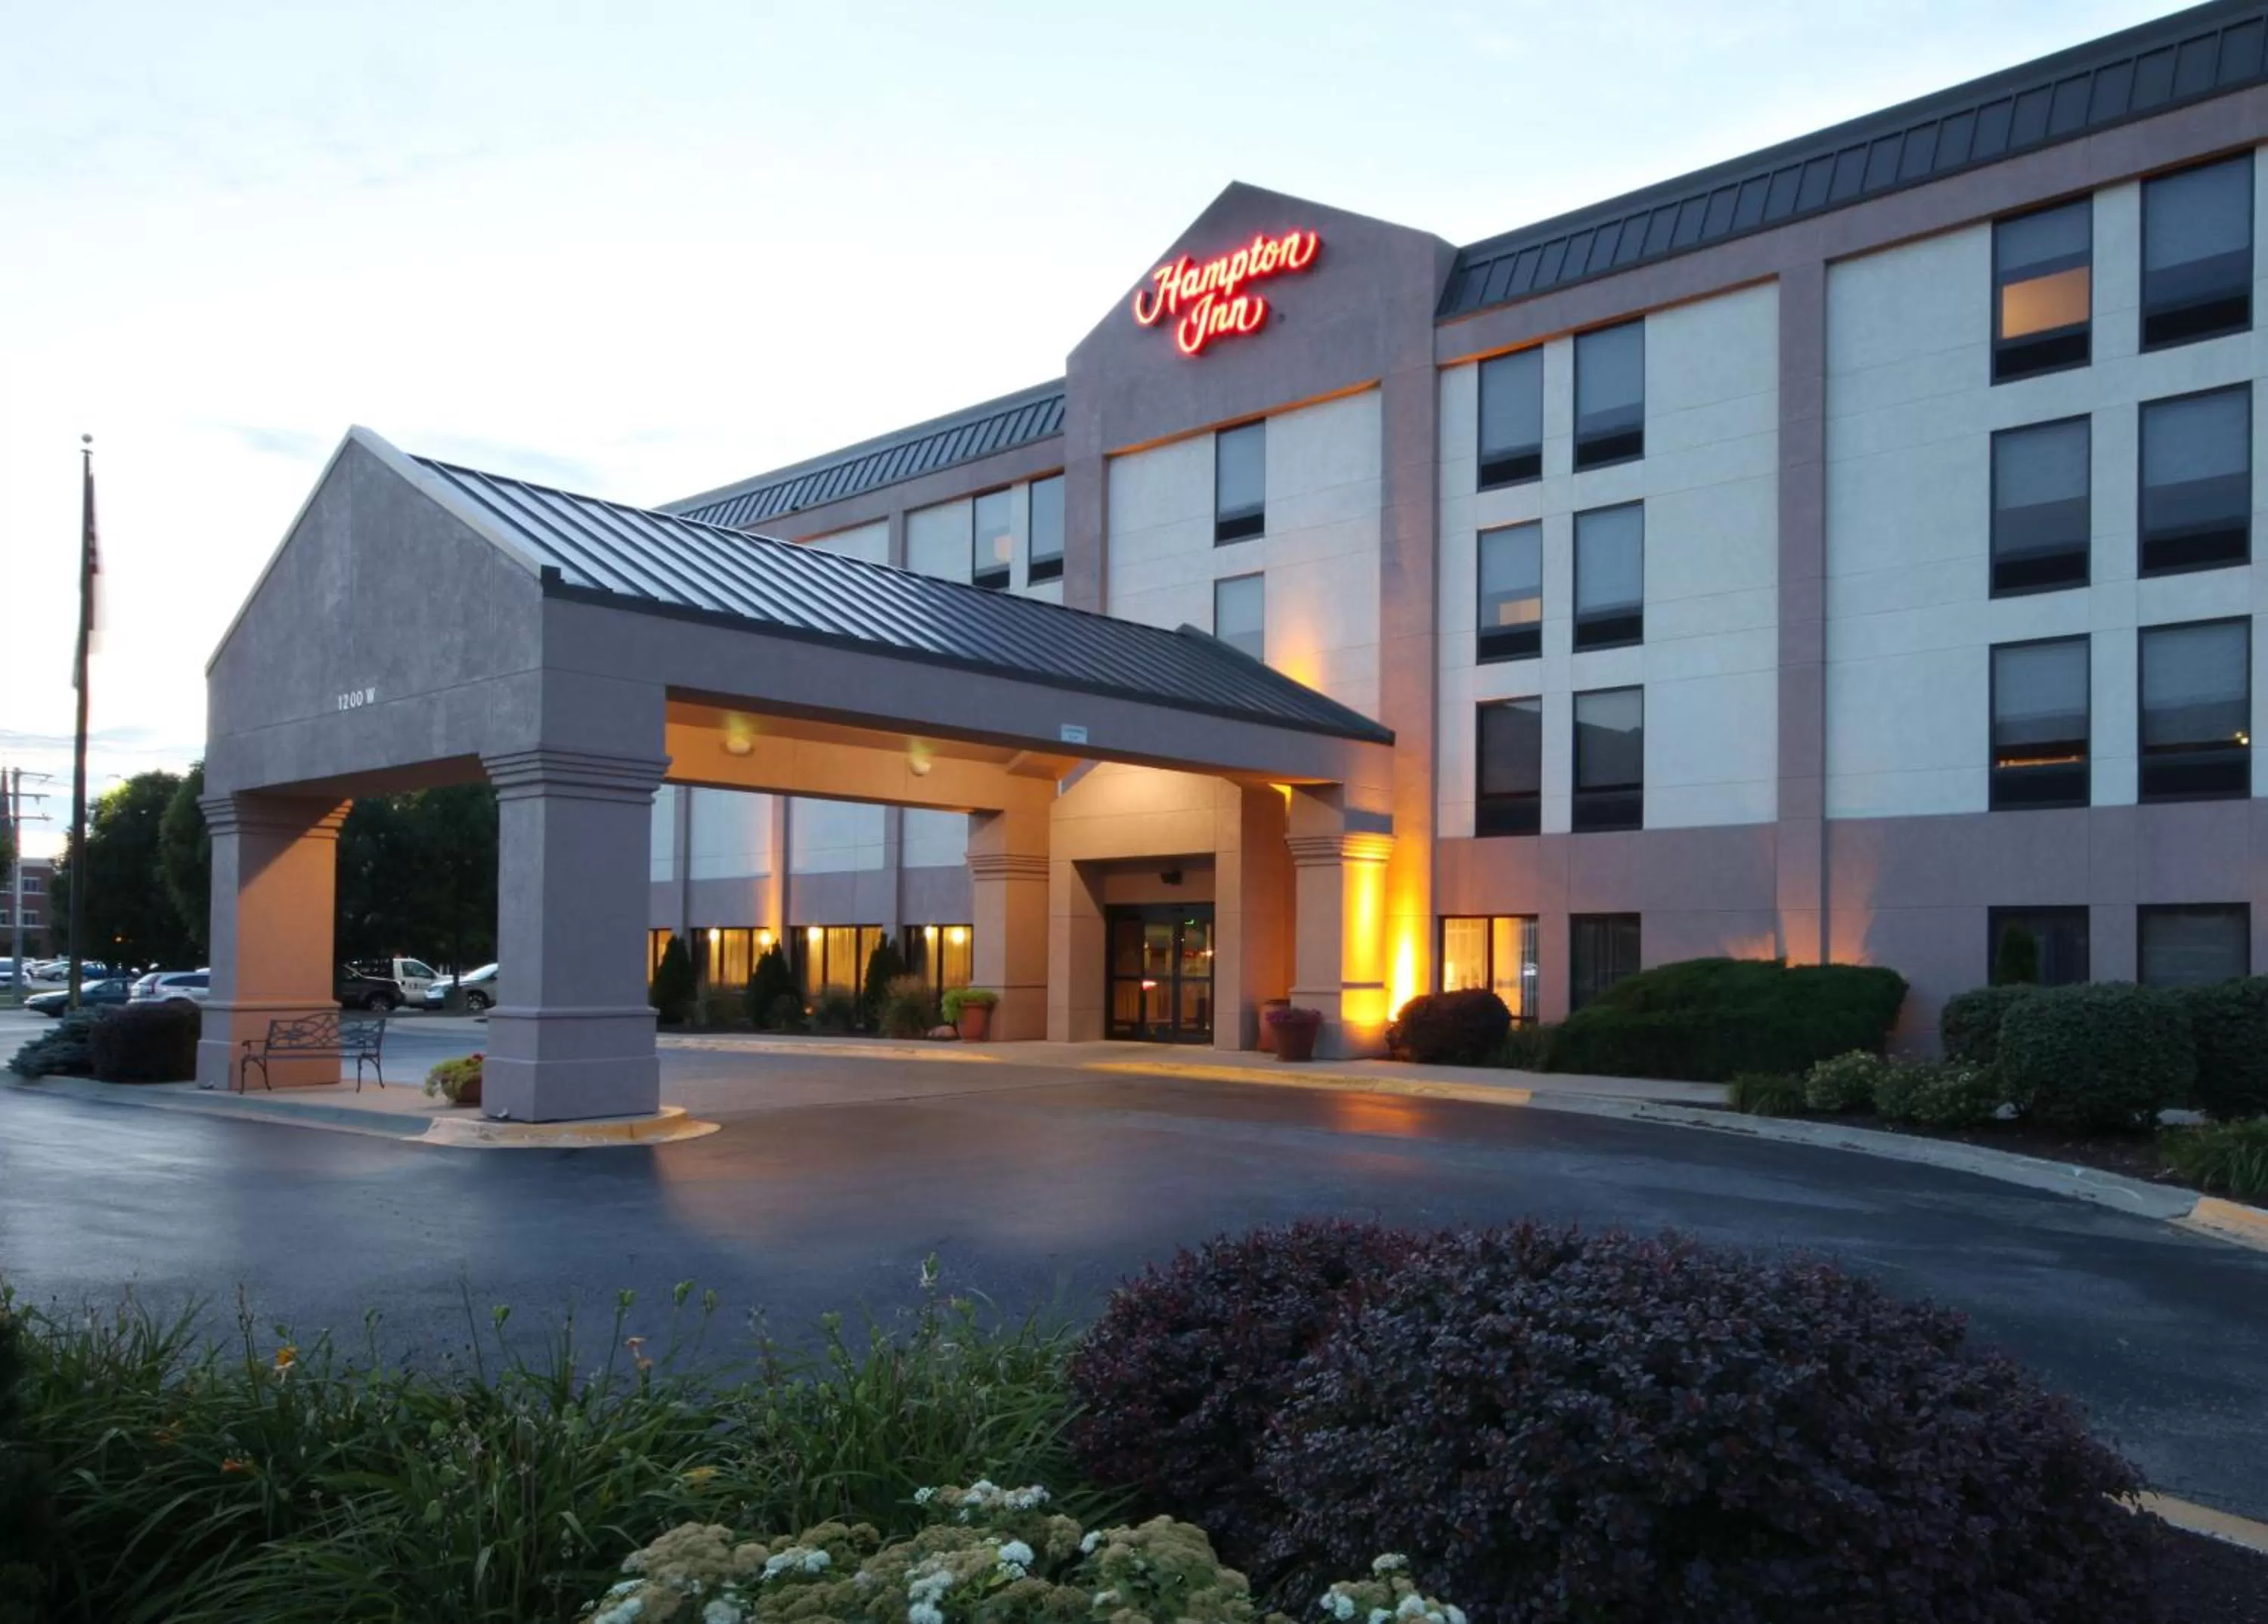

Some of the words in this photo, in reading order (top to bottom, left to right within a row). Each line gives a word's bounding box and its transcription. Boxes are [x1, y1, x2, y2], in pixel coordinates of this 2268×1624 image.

[1133, 229, 1320, 326] Hampton
[1176, 292, 1266, 355] Inn
[338, 690, 364, 711] 1200
